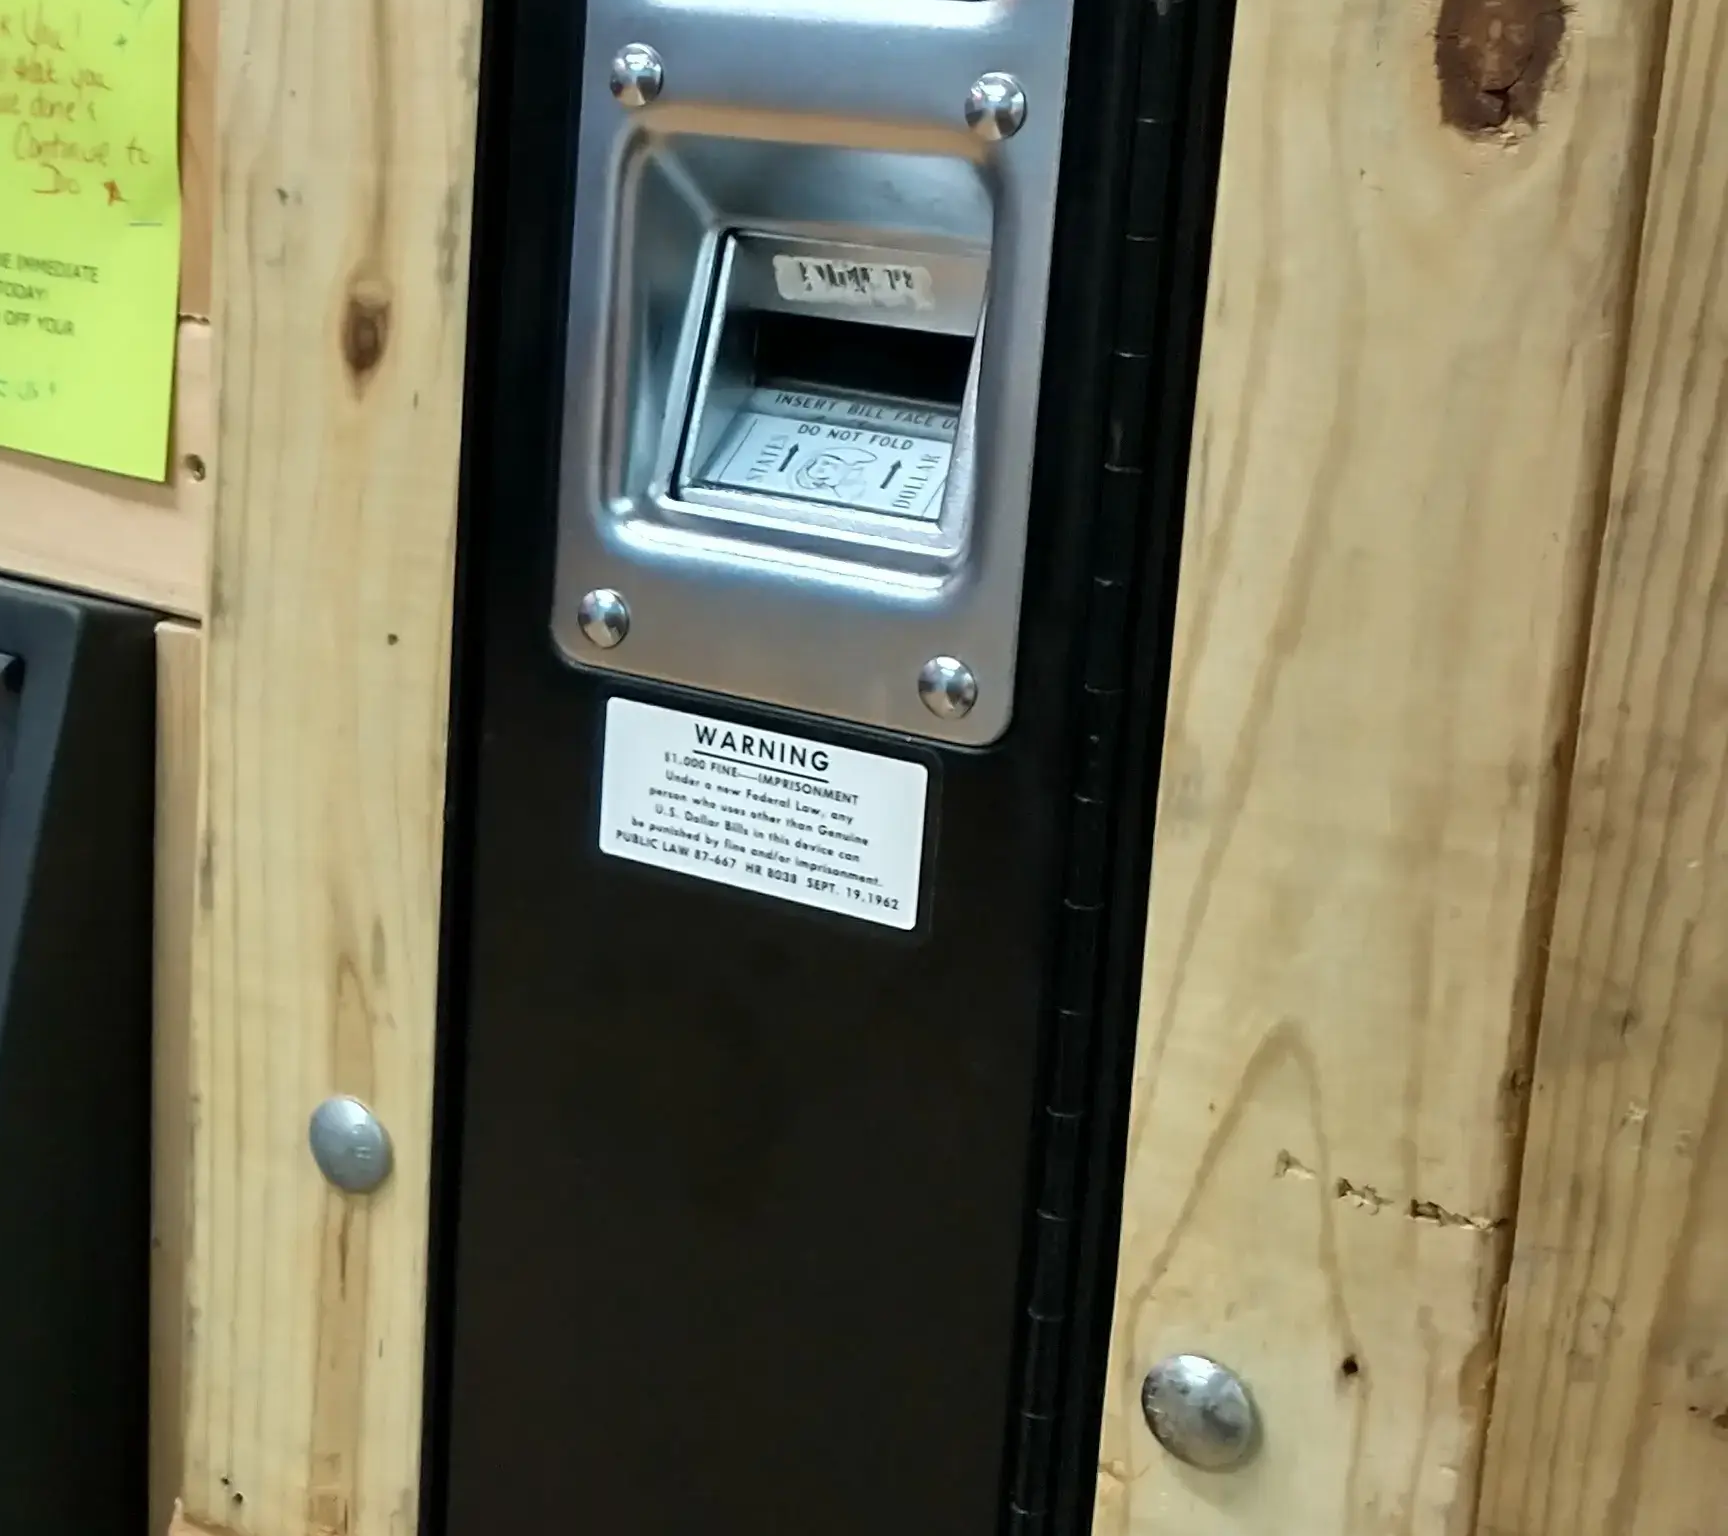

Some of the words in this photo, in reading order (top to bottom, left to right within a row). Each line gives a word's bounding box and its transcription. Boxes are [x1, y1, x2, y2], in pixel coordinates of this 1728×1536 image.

[4, 308, 31, 328] OFF
[37, 315, 76, 337] YOUR
[774, 392, 836, 412] INSERT
[847, 400, 883, 420] BILL
[893, 410, 935, 429] FACE
[797, 423, 822, 436] DO
[827, 426, 862, 442] NOT
[869, 434, 915, 451] FOLD
[891, 453, 942, 510] DOLLAR
[695, 723, 830, 772] WARNING
[648, 786, 687, 802] person
[692, 797, 717, 810] who
[720, 803, 746, 817] uses
[751, 810, 782, 825] other
[785, 817, 814, 833] than
[817, 824, 869, 847] Genuine
[665, 769, 701, 787] Under
[704, 782, 712, 790] a
[716, 784, 742, 797] new
[745, 788, 791, 809] Federal
[830, 811, 854, 825] any
[615, 828, 659, 850] PUBLIC
[662, 841, 690, 857] LAW
[694, 849, 737, 870] 87-667
[745, 862, 763, 876] HR
[631, 815, 645, 828] be
[648, 822, 701, 843] punished
[704, 835, 719, 849] by
[724, 838, 747, 854] fine
[750, 845, 791, 864] and/or
[684, 811, 720, 828] Dollar
[724, 820, 749, 836] Bills
[753, 827, 765, 839] in
[768, 832, 790, 847] this
[794, 838, 835, 857] device
[838, 850, 861, 863] can
